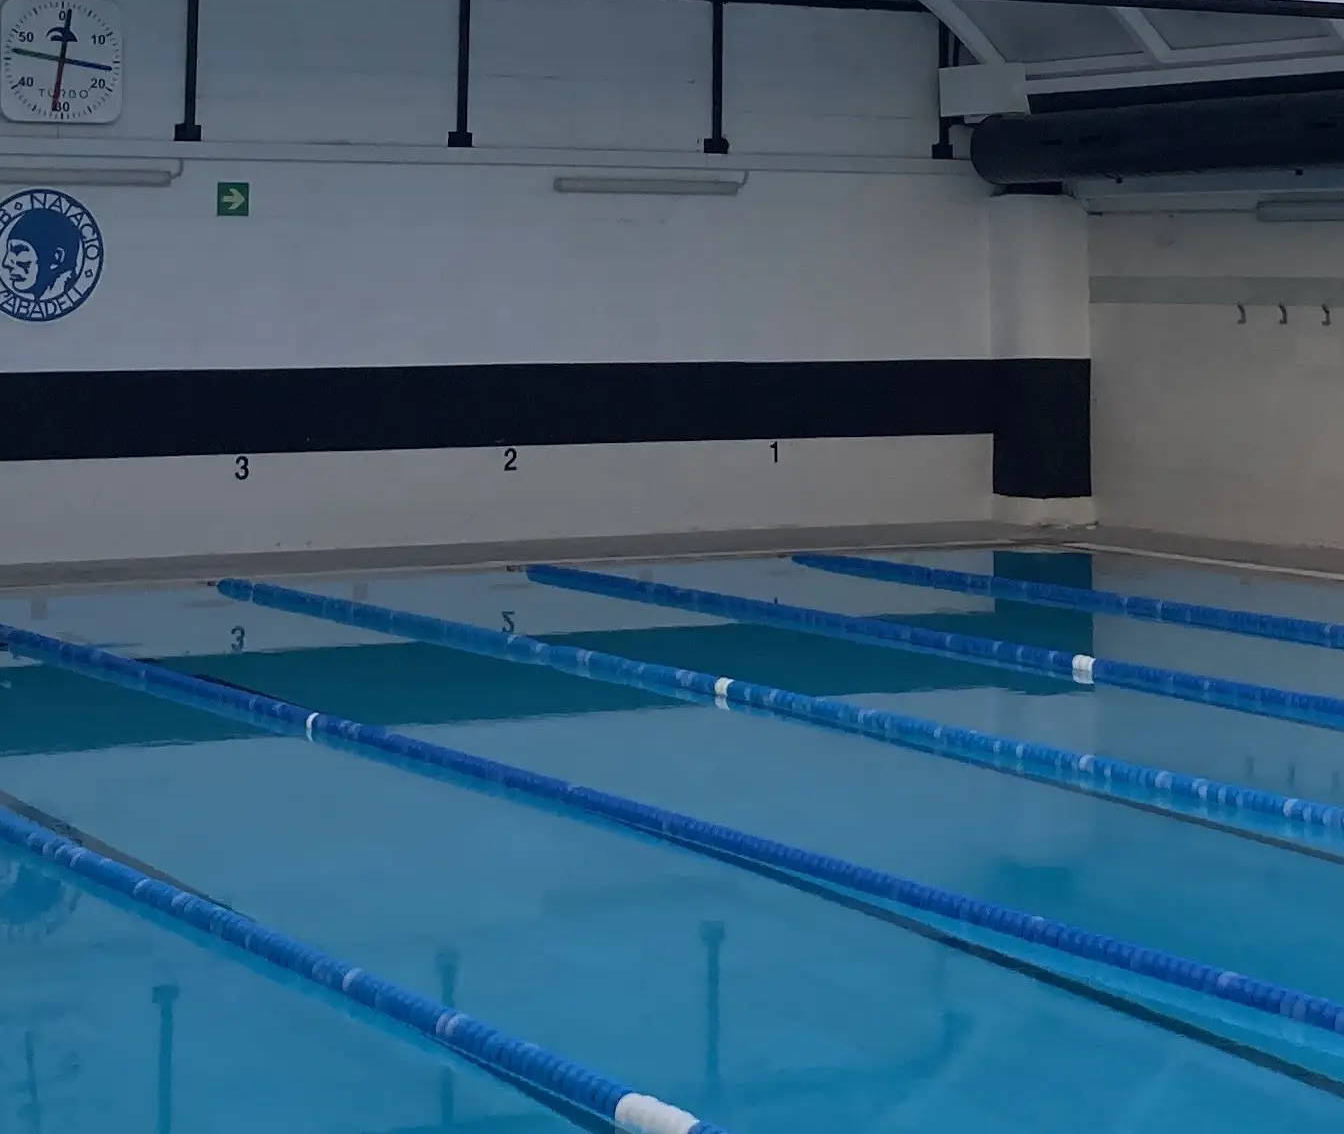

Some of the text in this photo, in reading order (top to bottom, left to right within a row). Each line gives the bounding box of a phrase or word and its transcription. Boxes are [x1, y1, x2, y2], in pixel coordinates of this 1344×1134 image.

[18, 31, 34, 43] 50
[91, 34, 106, 45] 10
[17, 76, 34, 87] 40
[90, 78, 106, 89] 20
[769, 441, 778, 463] 1
[504, 447, 518, 472] 2
[234, 455, 250, 481] 3
